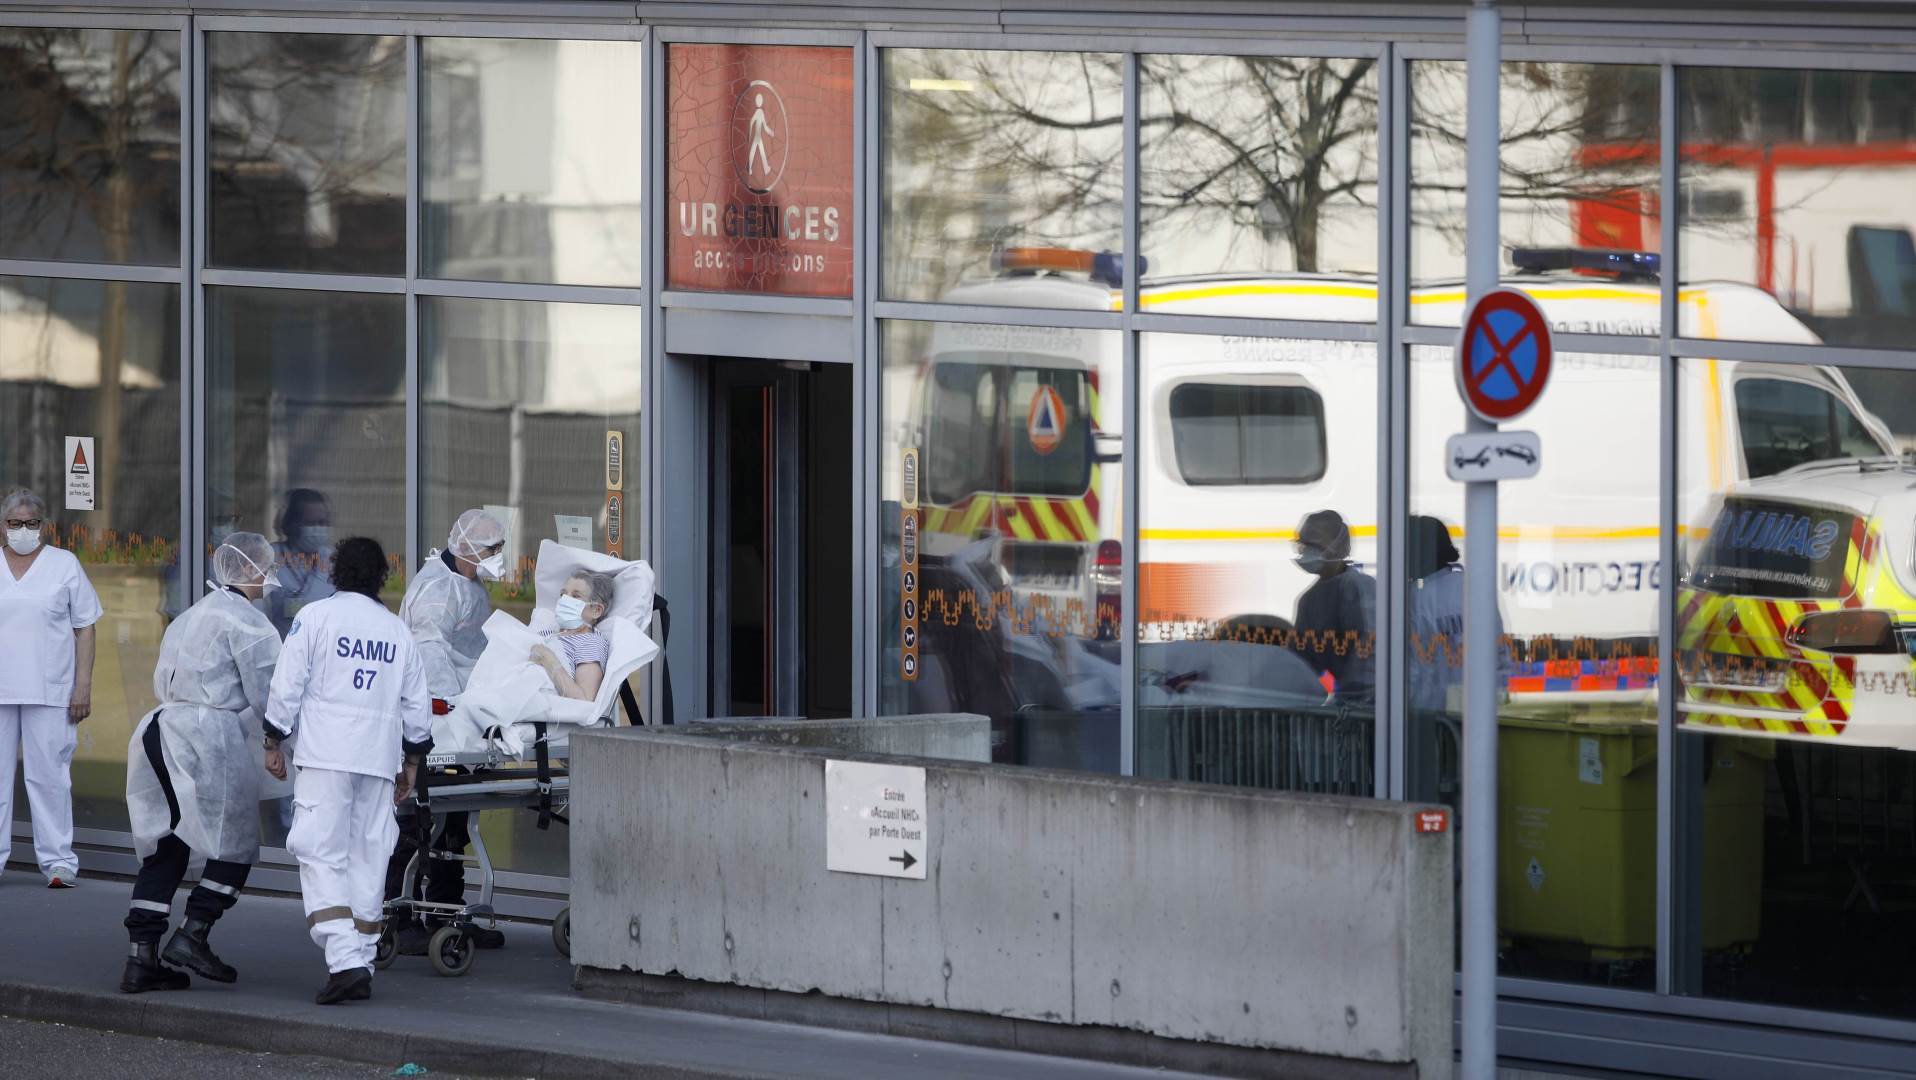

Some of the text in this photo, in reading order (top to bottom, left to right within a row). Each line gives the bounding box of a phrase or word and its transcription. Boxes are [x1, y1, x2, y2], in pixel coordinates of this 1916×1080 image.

[679, 201, 839, 242] URGENCES
[336, 636, 397, 664] SAMU
[352, 668, 377, 691] 67
[869, 825, 921, 840] par Porte Ouest
